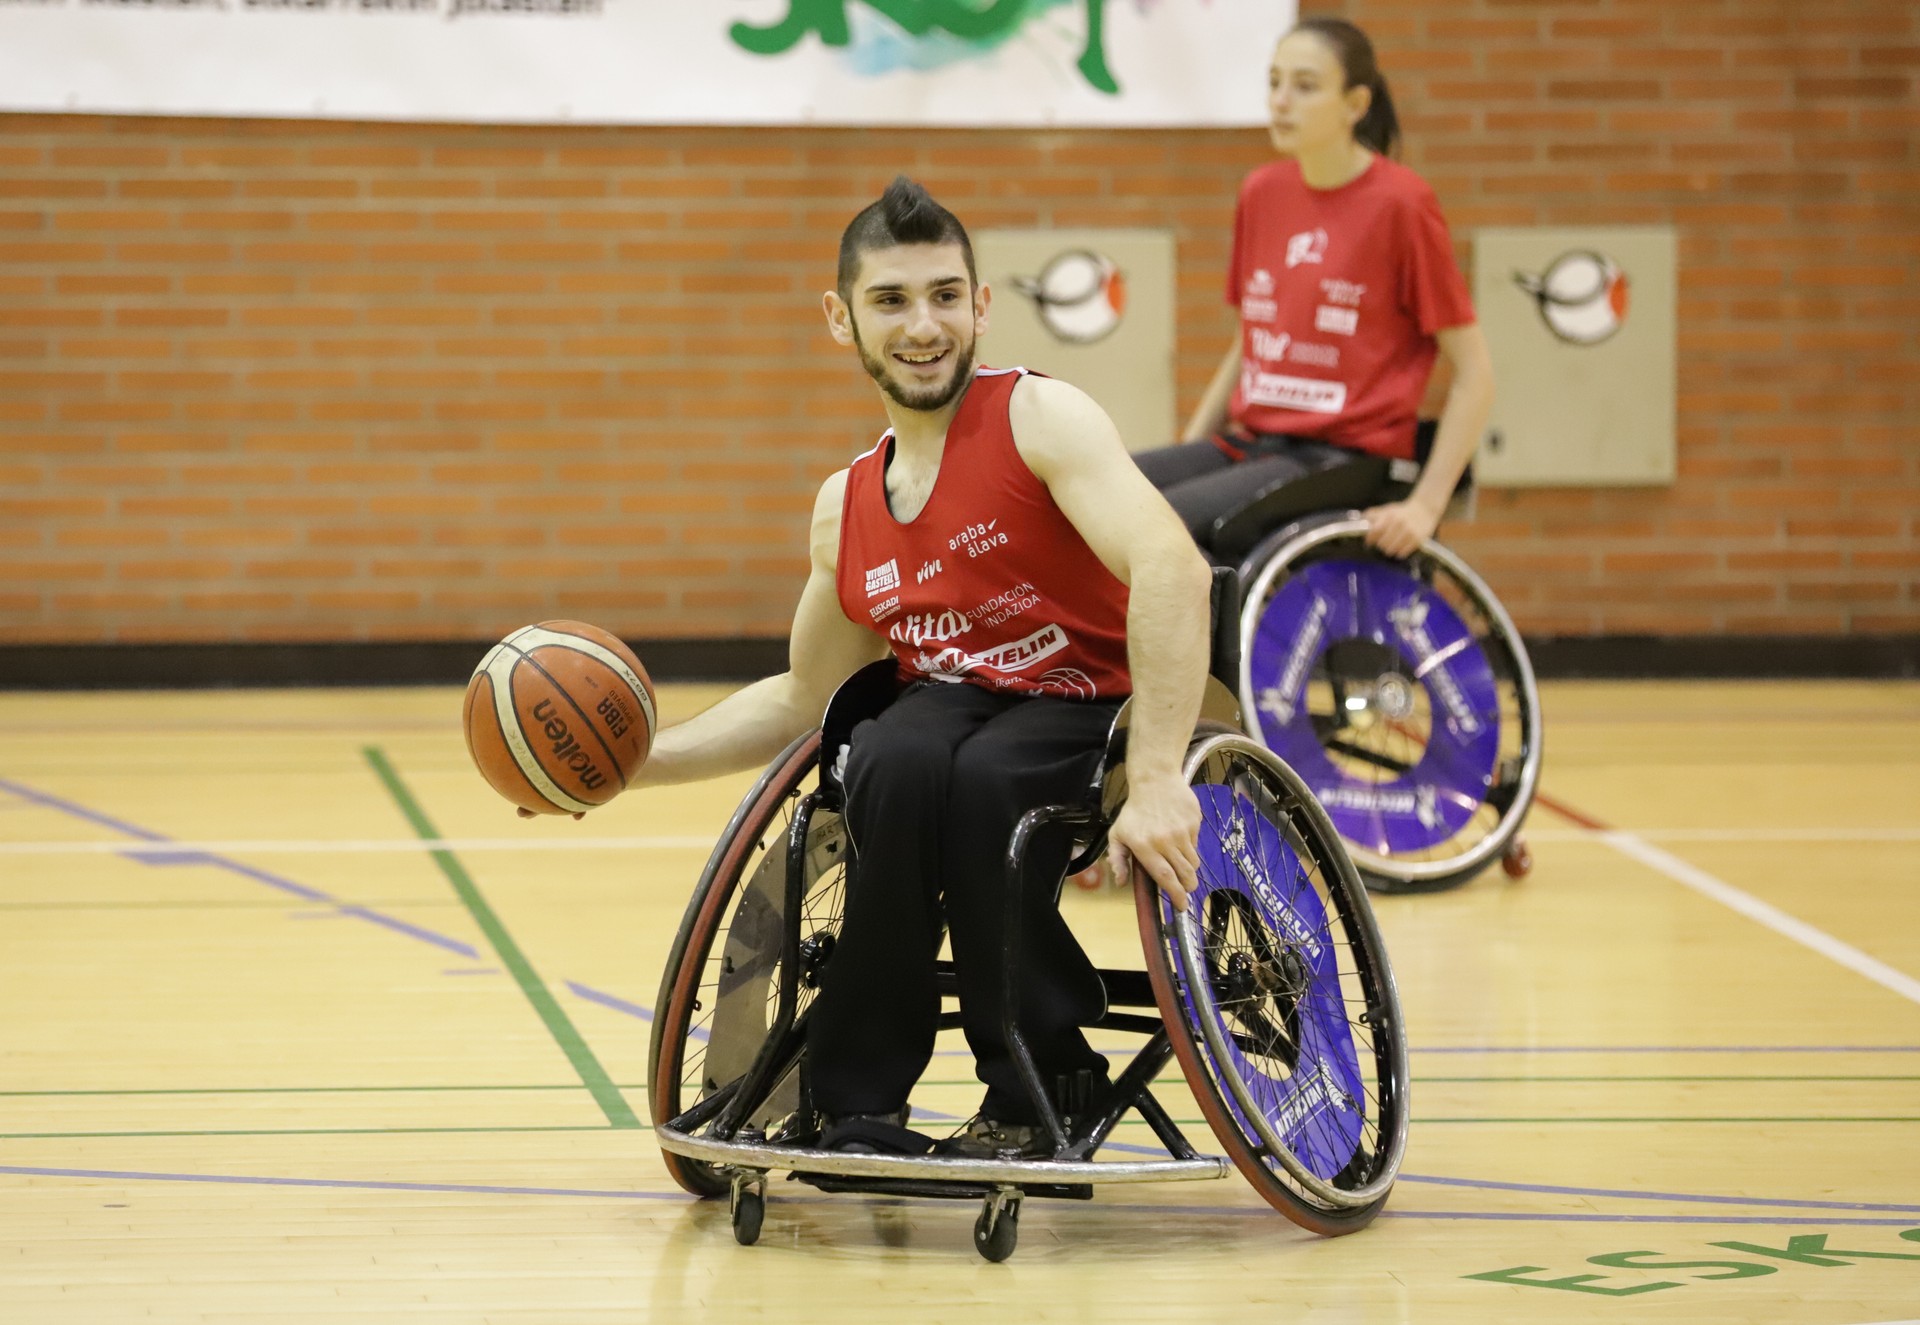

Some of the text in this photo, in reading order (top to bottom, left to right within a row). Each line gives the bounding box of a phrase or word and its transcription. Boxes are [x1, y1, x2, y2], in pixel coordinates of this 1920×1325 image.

[948, 523, 987, 551] araba
[967, 532, 1009, 558] álava
[869, 595, 899, 618] EUSKADI
[532, 698, 608, 791] molten
[1457, 1228, 1920, 1297] ESK
